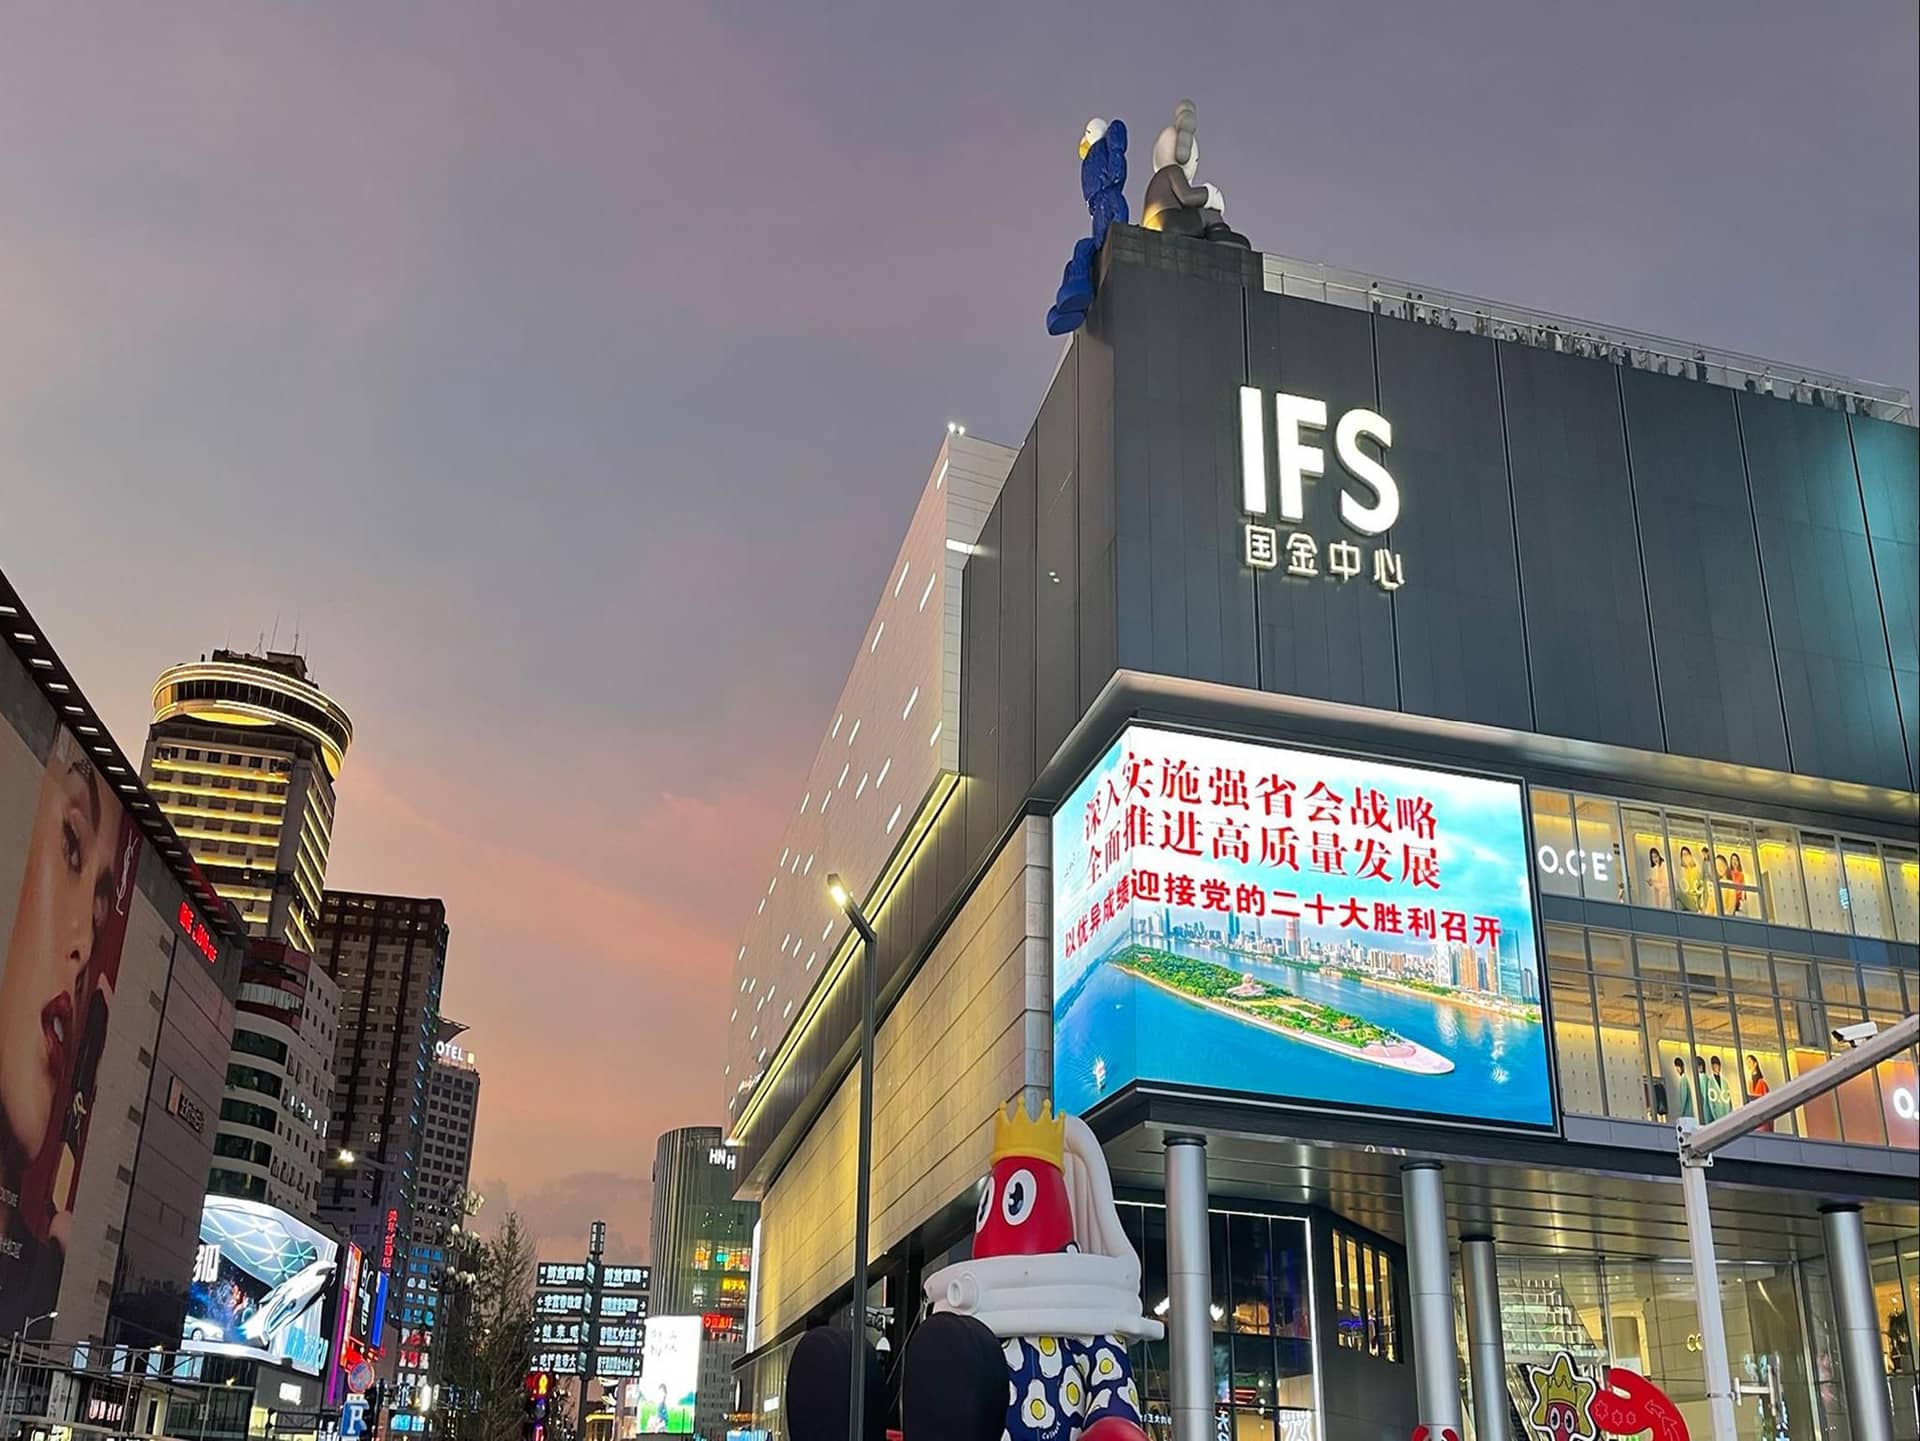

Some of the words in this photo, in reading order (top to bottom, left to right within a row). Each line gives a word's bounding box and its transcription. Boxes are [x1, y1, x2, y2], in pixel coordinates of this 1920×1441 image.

[1240, 385, 1400, 535] IFS
[1245, 523, 1405, 590] 国金中心
[1084, 751, 1438, 842] 深入实施强省会战略
[1086, 804, 1442, 891] 全面推进高质量发展
[1064, 867, 1502, 959] 以优异成绩迎接党的二十大胜利召开
